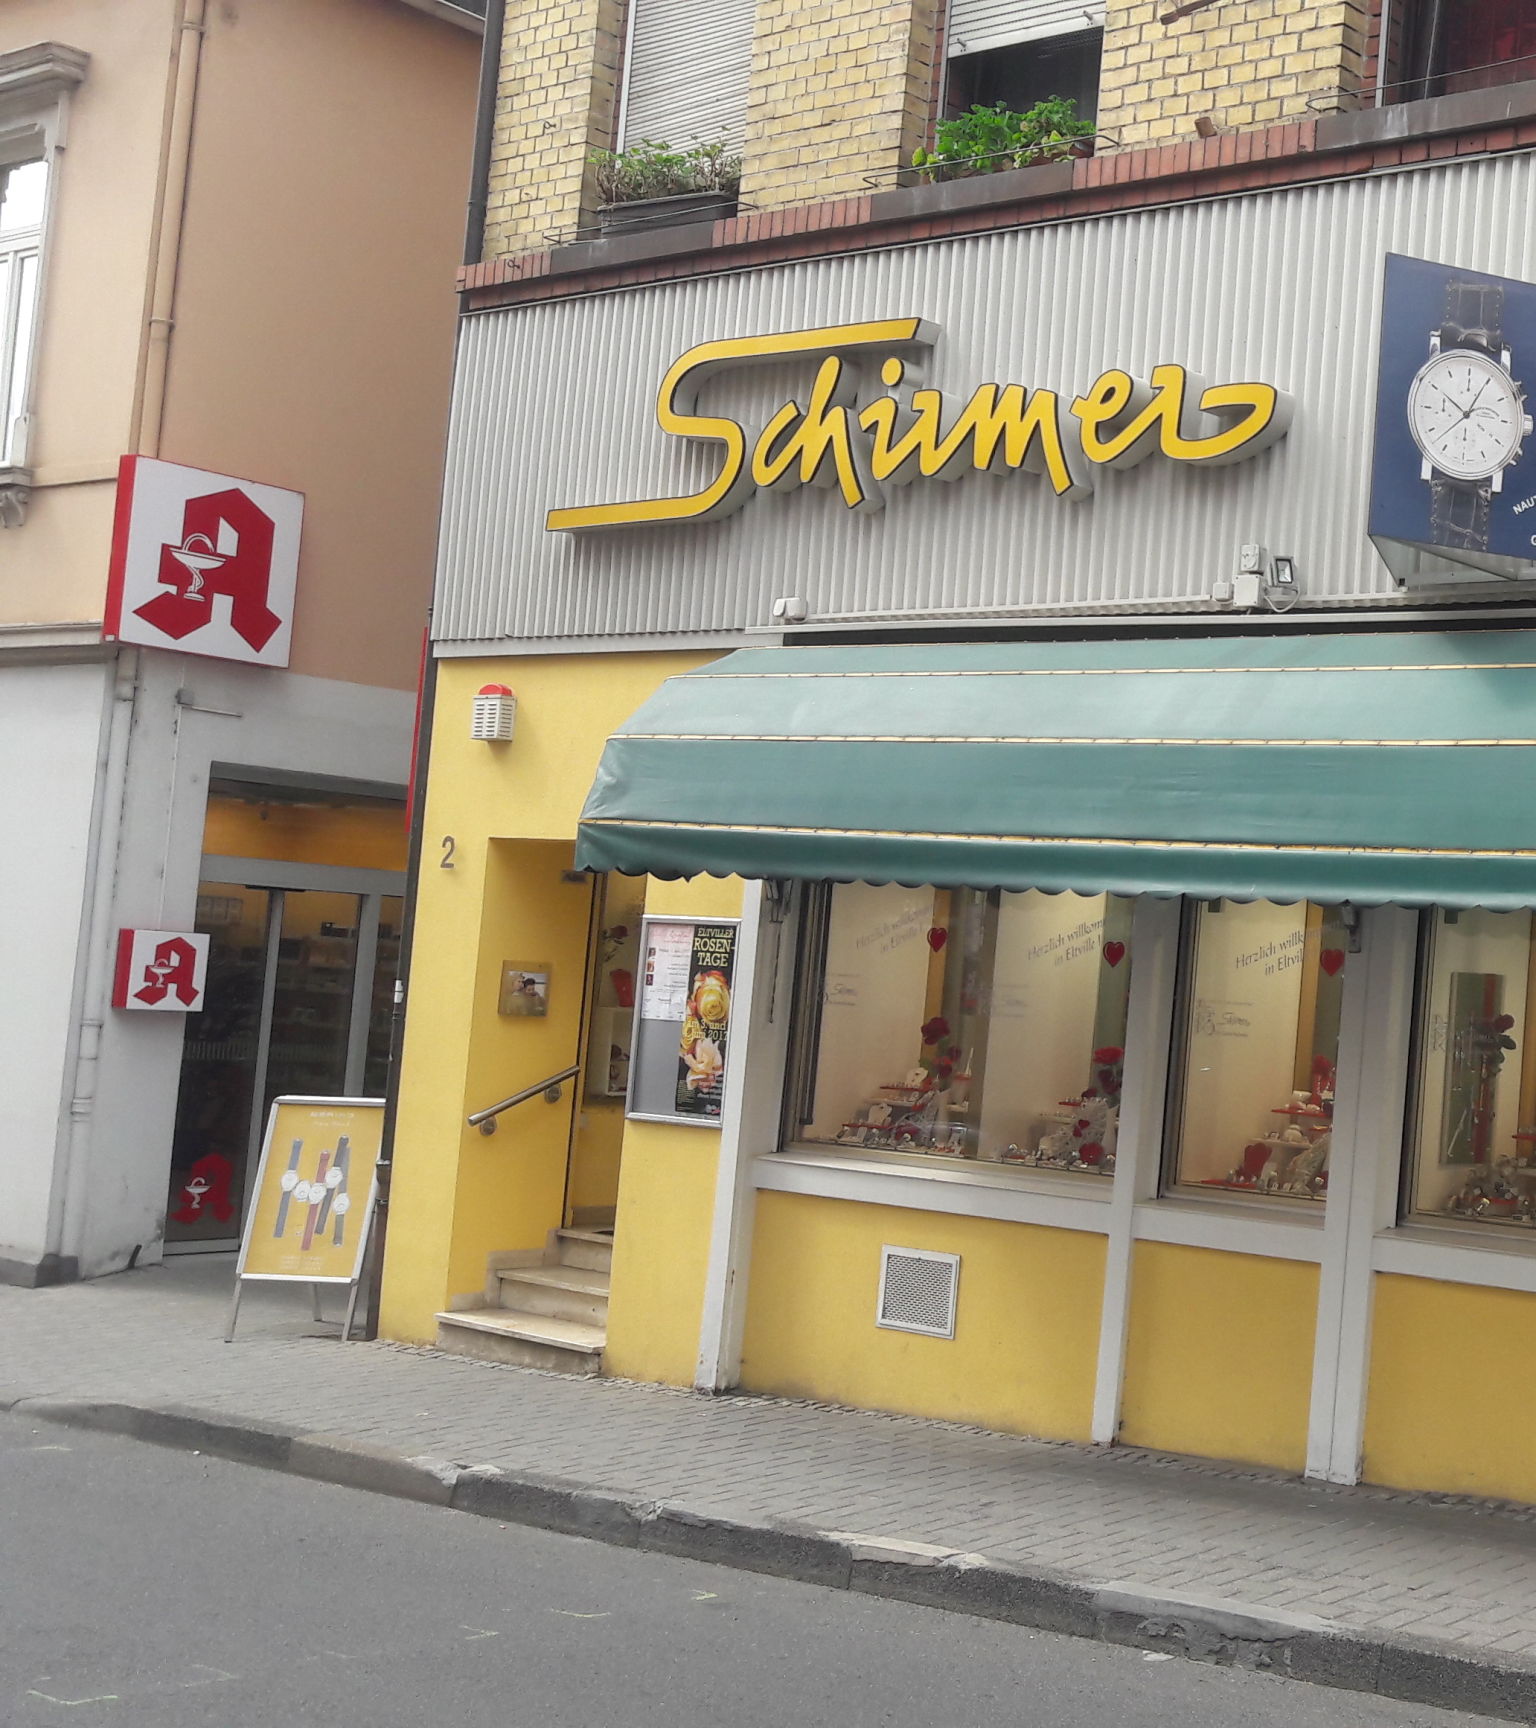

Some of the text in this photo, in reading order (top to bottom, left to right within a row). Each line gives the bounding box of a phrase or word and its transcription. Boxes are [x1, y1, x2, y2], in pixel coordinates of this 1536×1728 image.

[546, 317, 1276, 531] Schirmer
[440, 836, 455, 868] 2
[693, 937, 736, 953] ROSEN-
[697, 927, 734, 938] ELTVILLER
[697, 952, 729, 967] TAGE
[1028, 934, 1065, 961] Herzlich
[1054, 955, 1064, 967] in
[1066, 938, 1095, 961] Eltville
[1236, 941, 1276, 969] Herzlich
[1265, 963, 1275, 976] in
